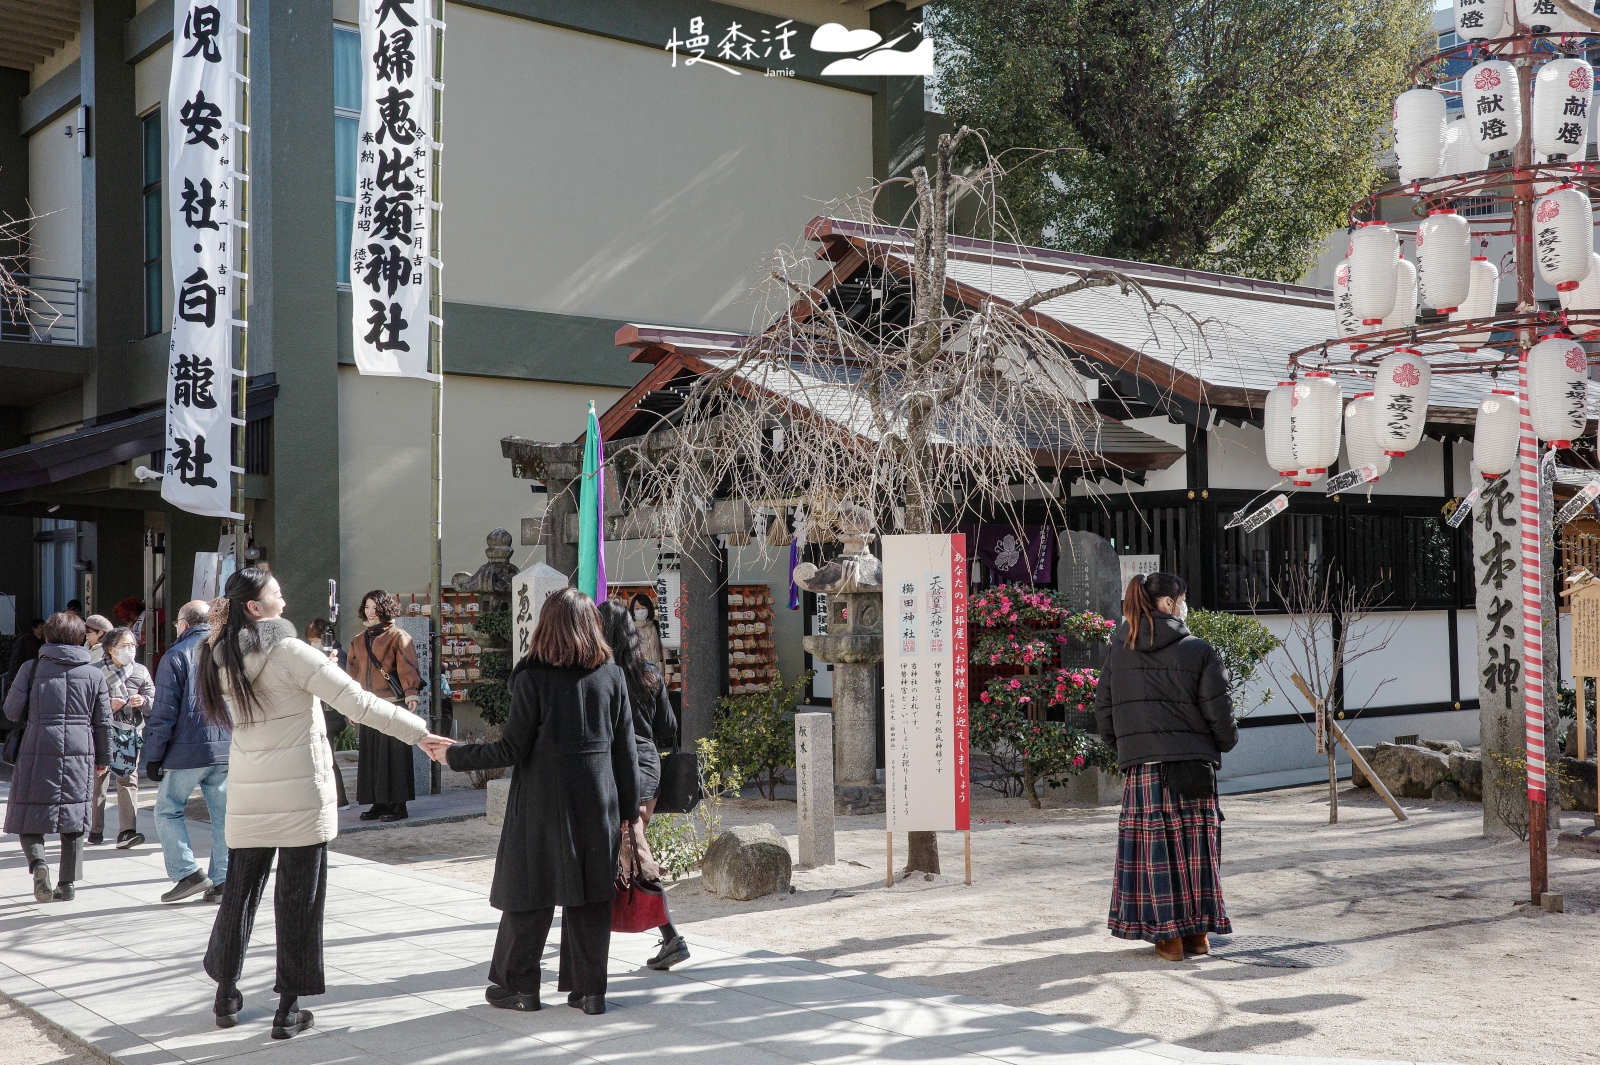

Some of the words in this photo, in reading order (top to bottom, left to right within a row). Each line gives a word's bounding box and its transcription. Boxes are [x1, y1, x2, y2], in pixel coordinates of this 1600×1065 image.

[1477, 94, 1508, 140] 献燈
[1555, 95, 1588, 145] 献燈
[360, 131, 375, 164] 奉納
[217, 133, 230, 295] 令和八年一月吉日
[357, 178, 374, 232] 北方邦昭
[412, 127, 426, 285] 令和七年十二月吉日
[353, 248, 367, 274] 徳子
[1386, 394, 1415, 440] 吉塚うなぎ
[902, 583, 915, 639] 櫛田神社
[953, 552, 967, 803] あなたのお部屋にお神様をお迎えしましょう
